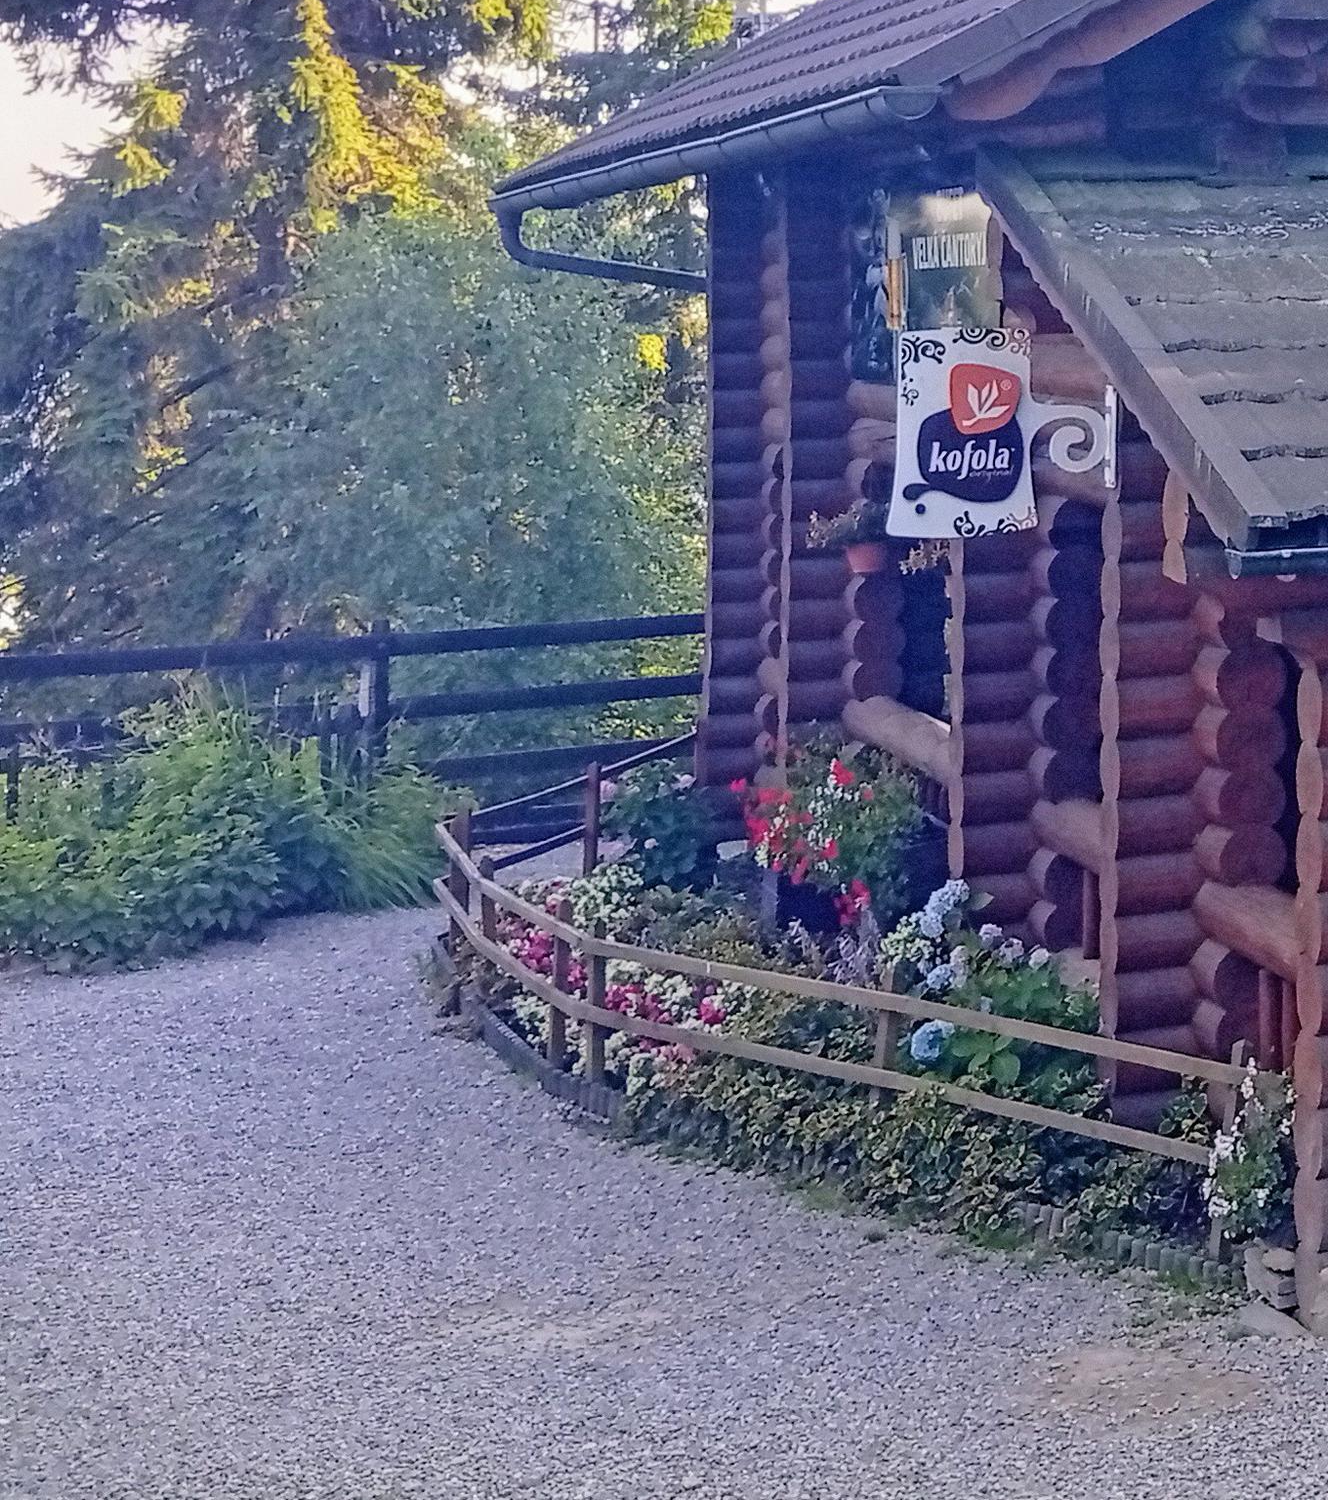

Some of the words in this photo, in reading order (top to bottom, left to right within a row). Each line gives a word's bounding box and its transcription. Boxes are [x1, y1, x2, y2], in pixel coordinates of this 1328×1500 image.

[912, 228, 940, 270] VELKÁ
[941, 227, 987, 268] ČANTORYJ
[928, 439, 1010, 480] kofola
